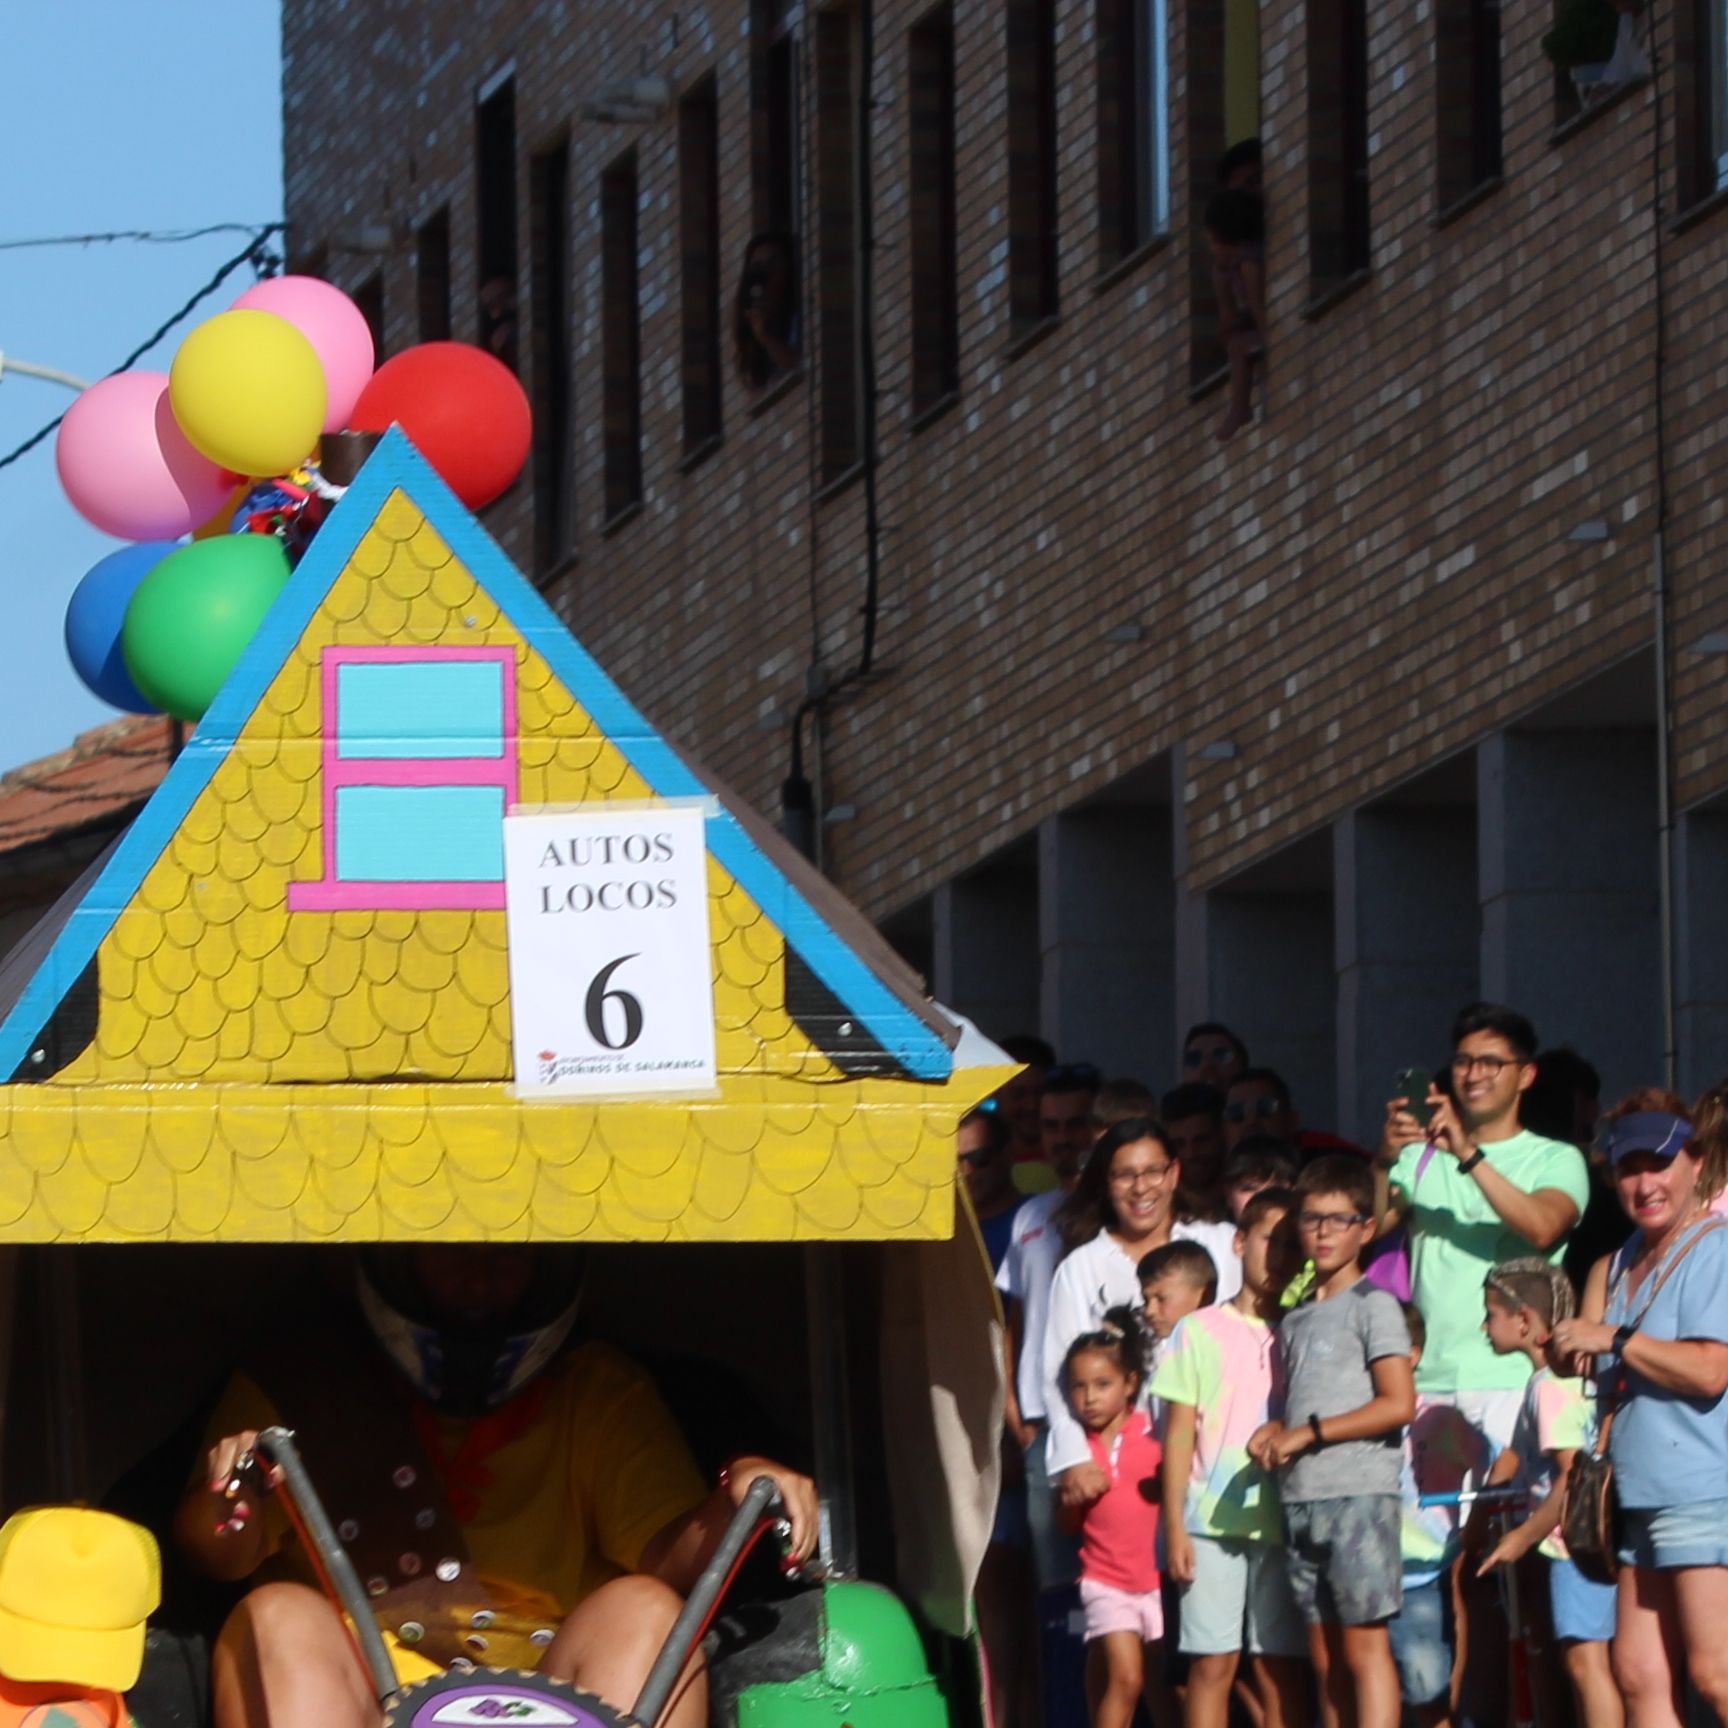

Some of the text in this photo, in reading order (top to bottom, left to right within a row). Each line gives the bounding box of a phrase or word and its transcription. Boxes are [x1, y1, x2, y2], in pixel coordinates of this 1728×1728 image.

[538, 832, 675, 869] AUTOS
[539, 879, 678, 914] LOCOS
[583, 951, 644, 1051] 6
